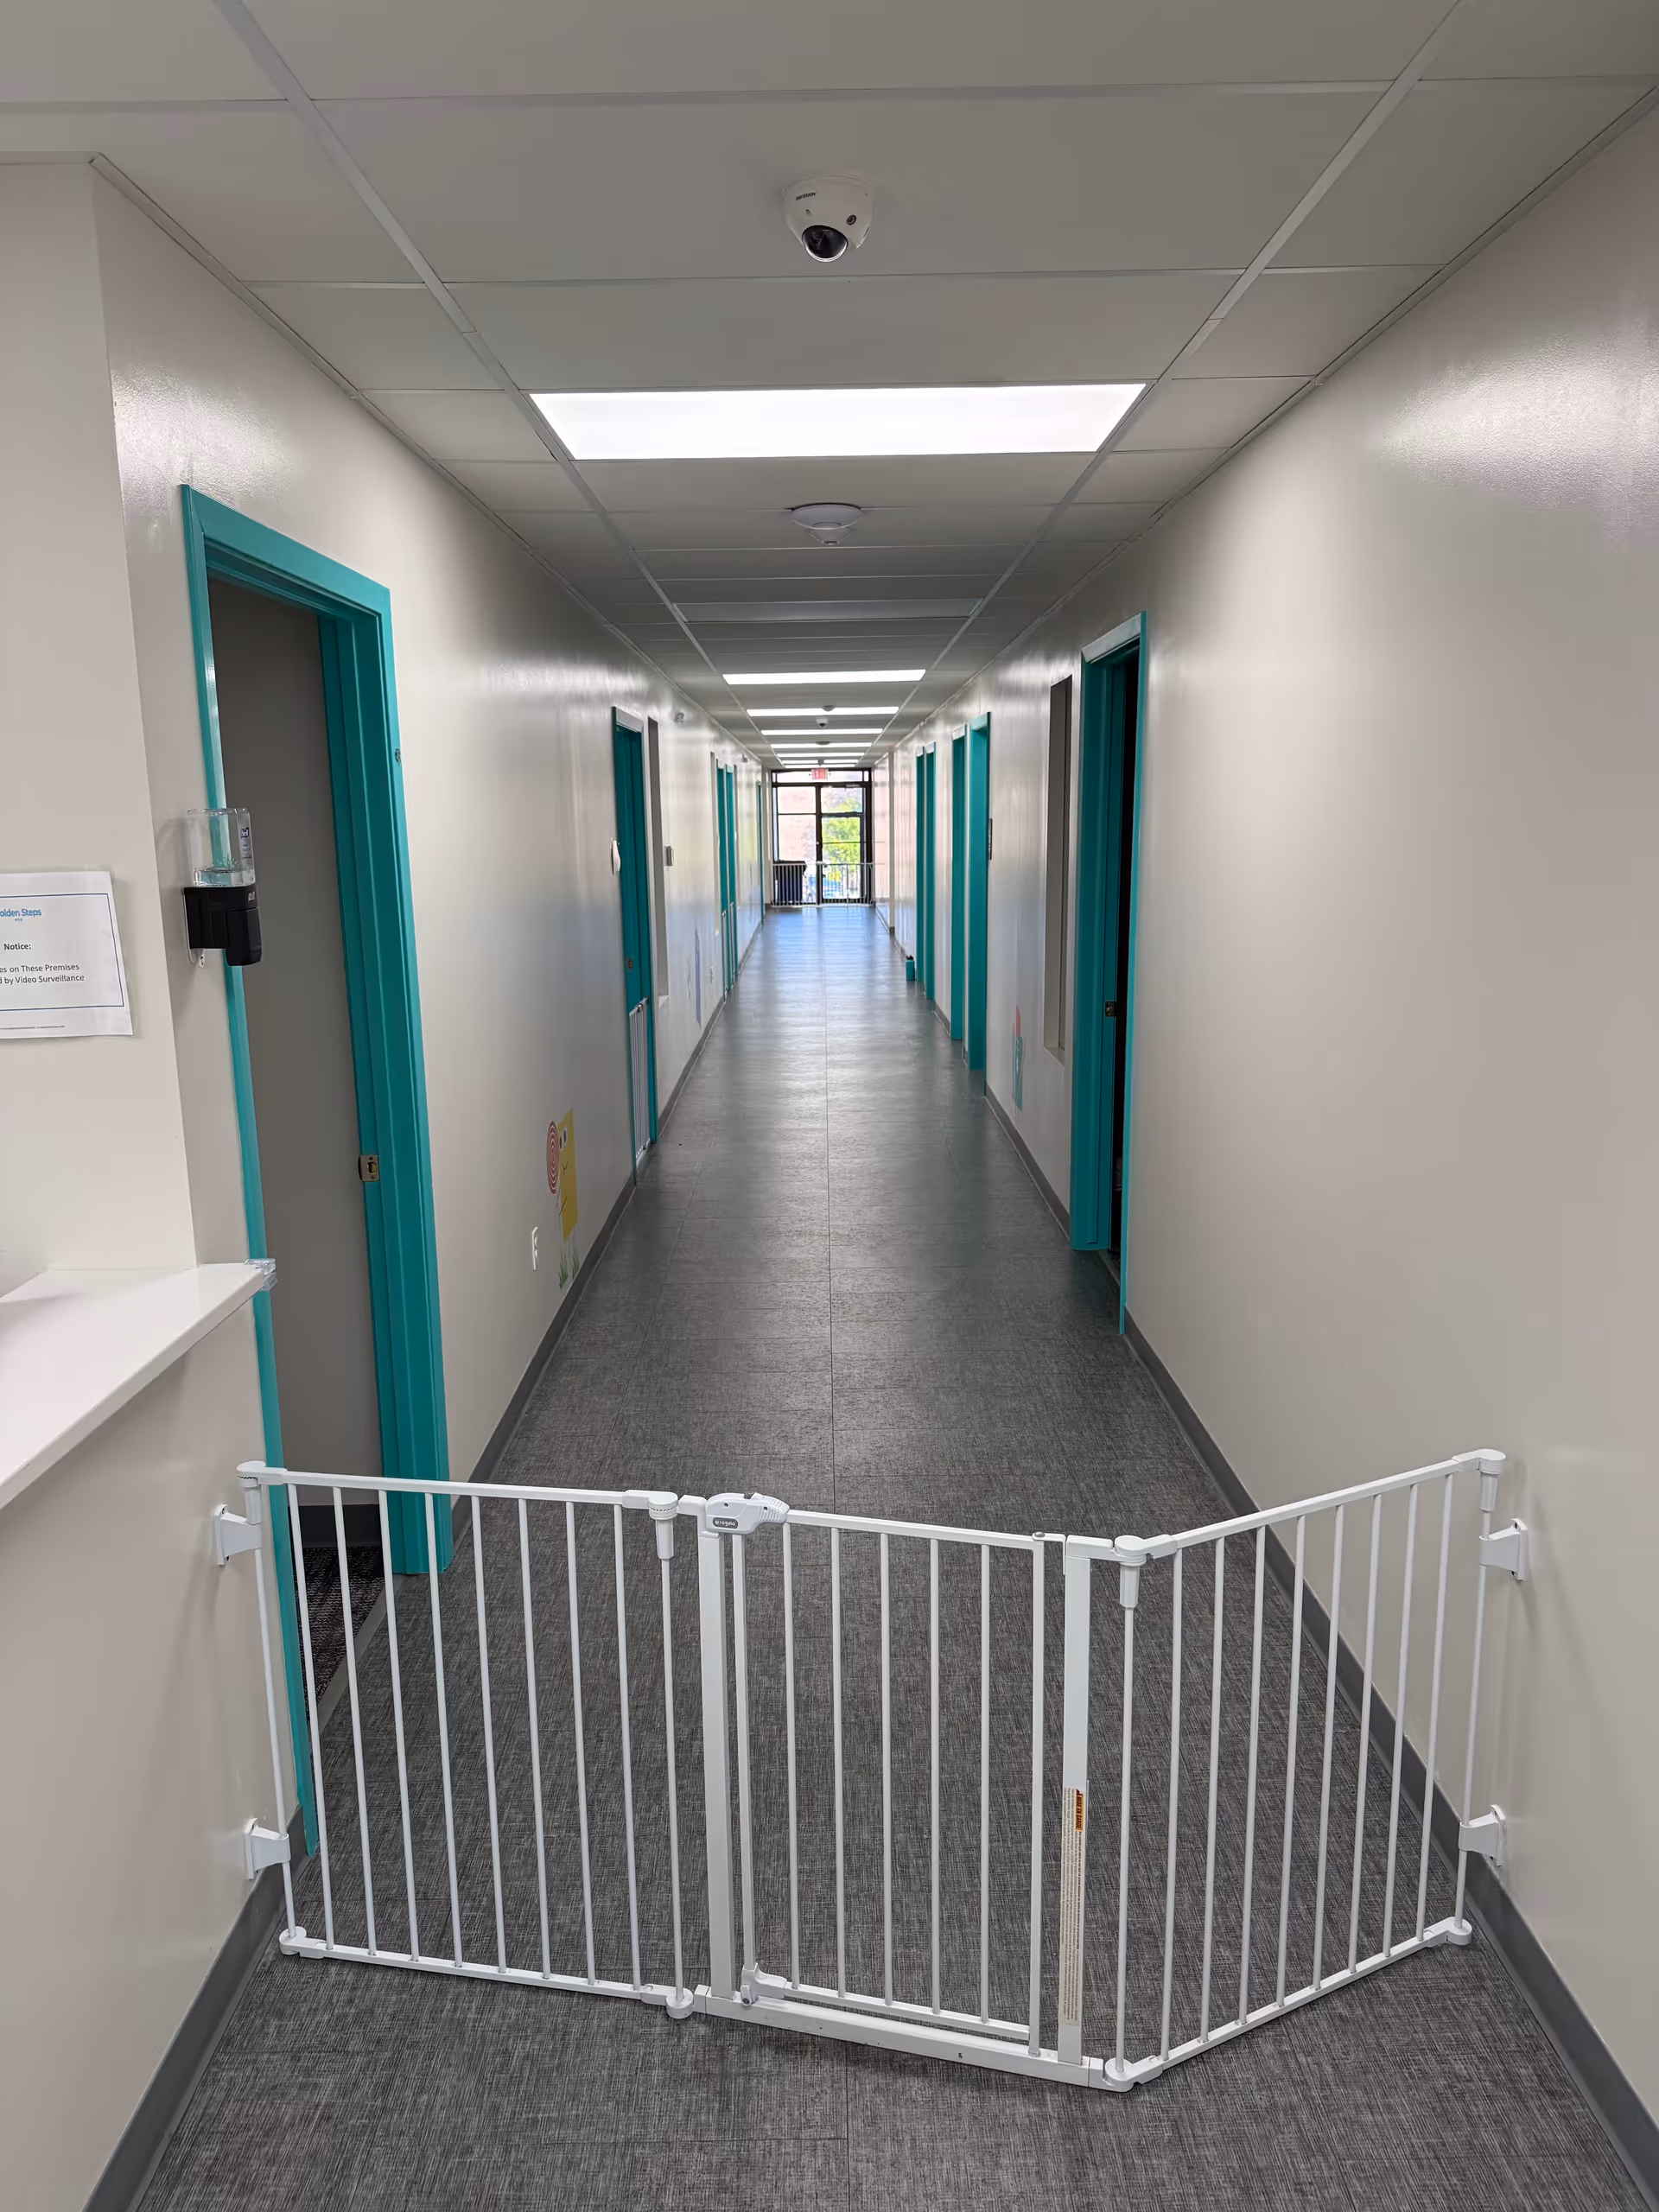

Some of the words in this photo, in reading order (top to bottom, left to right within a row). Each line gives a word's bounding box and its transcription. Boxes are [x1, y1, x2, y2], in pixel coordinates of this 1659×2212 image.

[21, 908, 42, 918] Steps
[4, 976, 14, 985] by
[38, 975, 85, 983] Surveillance
